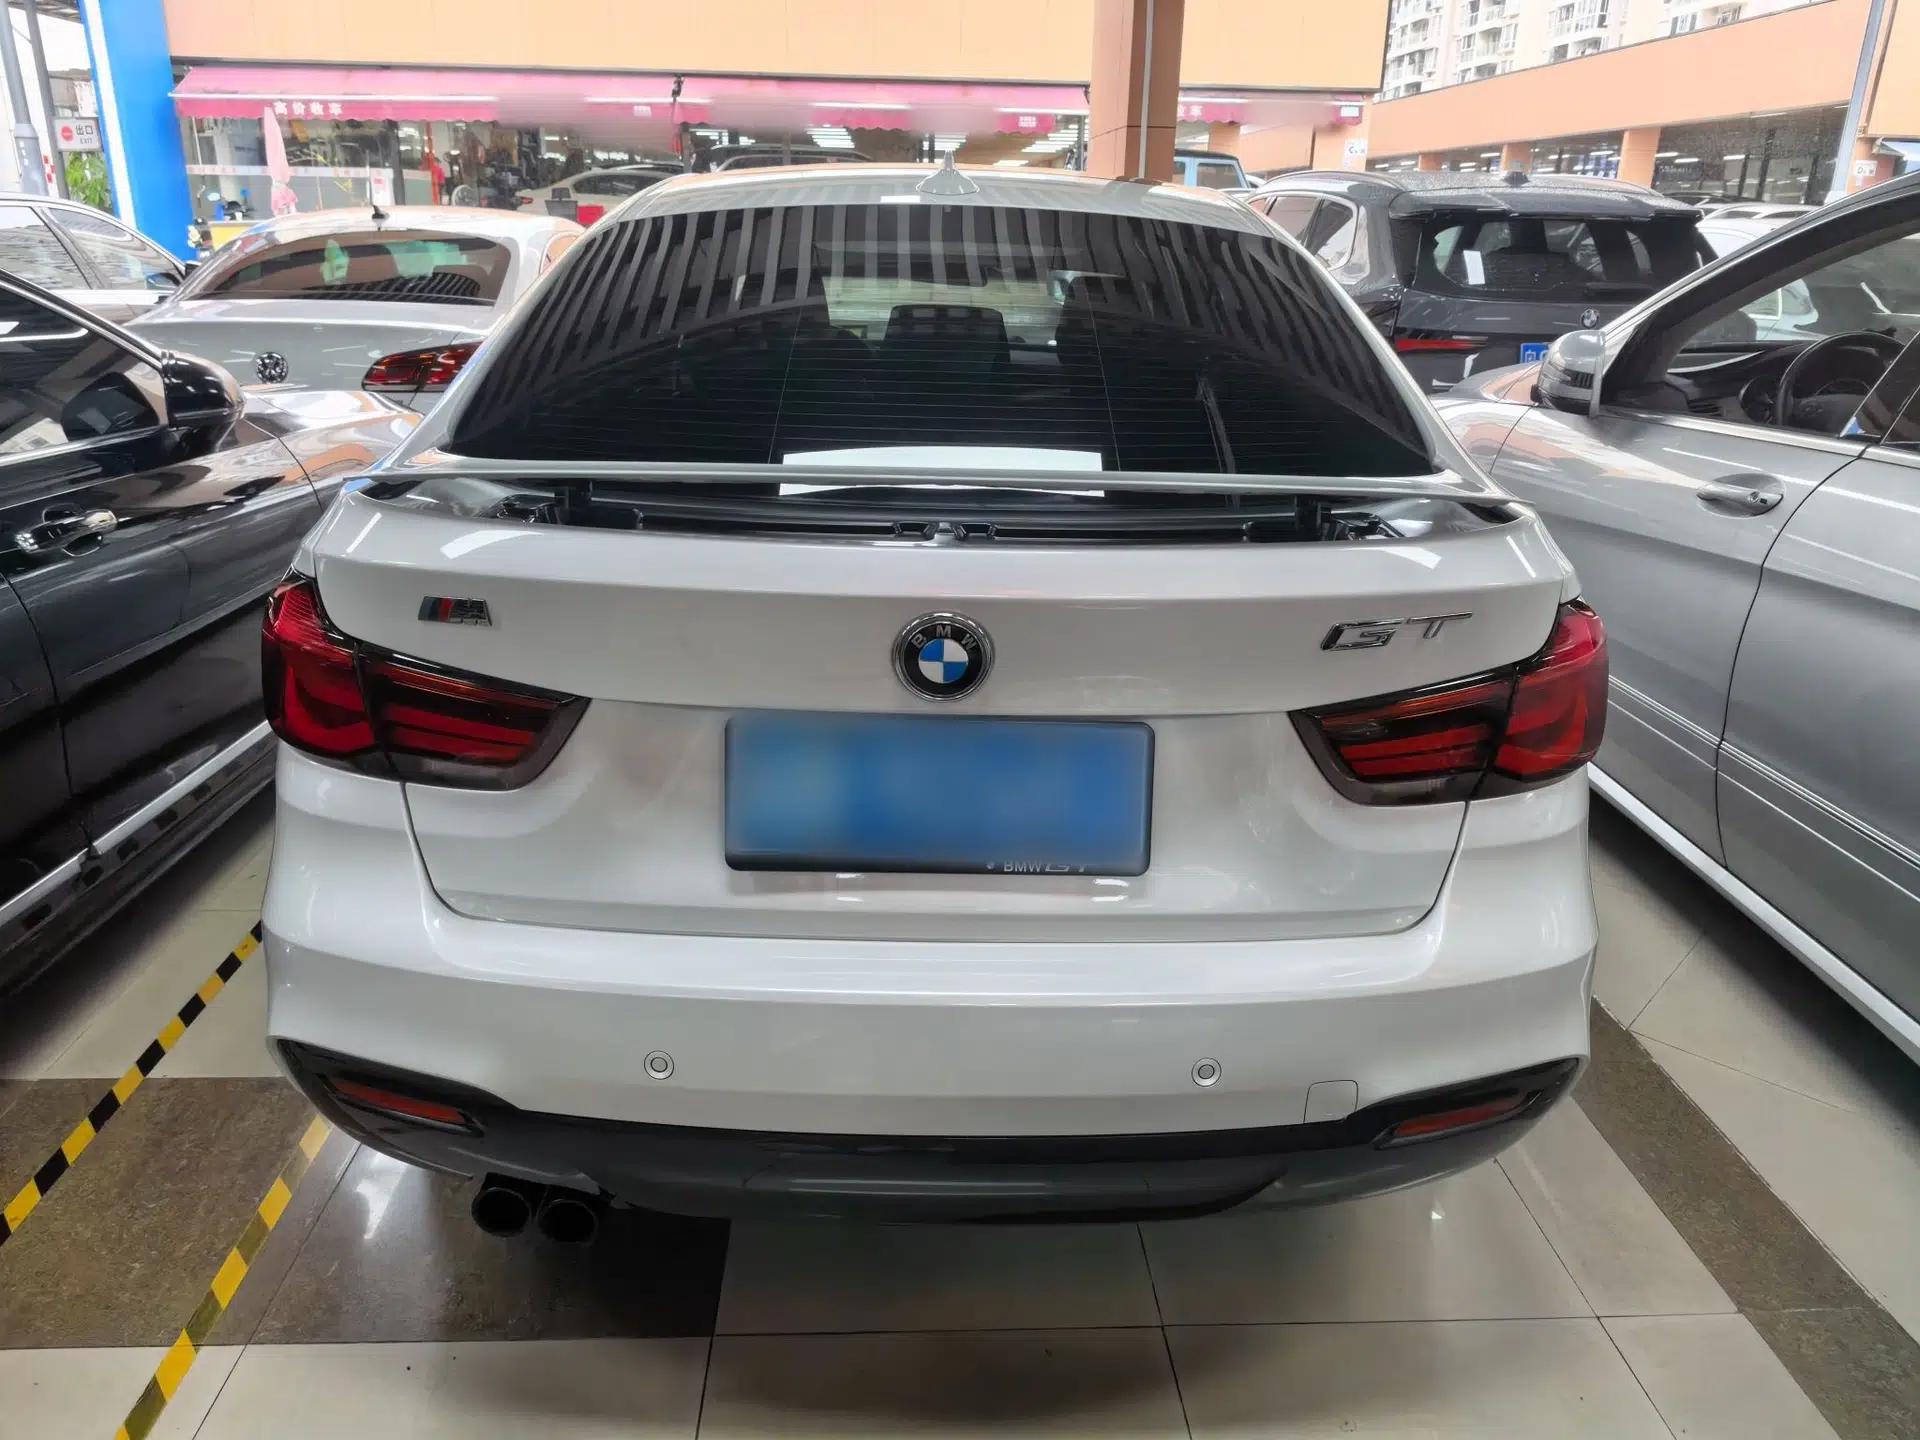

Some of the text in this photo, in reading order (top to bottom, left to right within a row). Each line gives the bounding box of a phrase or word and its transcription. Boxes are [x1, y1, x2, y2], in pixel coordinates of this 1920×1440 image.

[75, 125, 93, 135] 出口
[911, 624, 977, 650] BMW
[1320, 611, 1473, 651] GT
[1003, 861, 1040, 872] BMW
